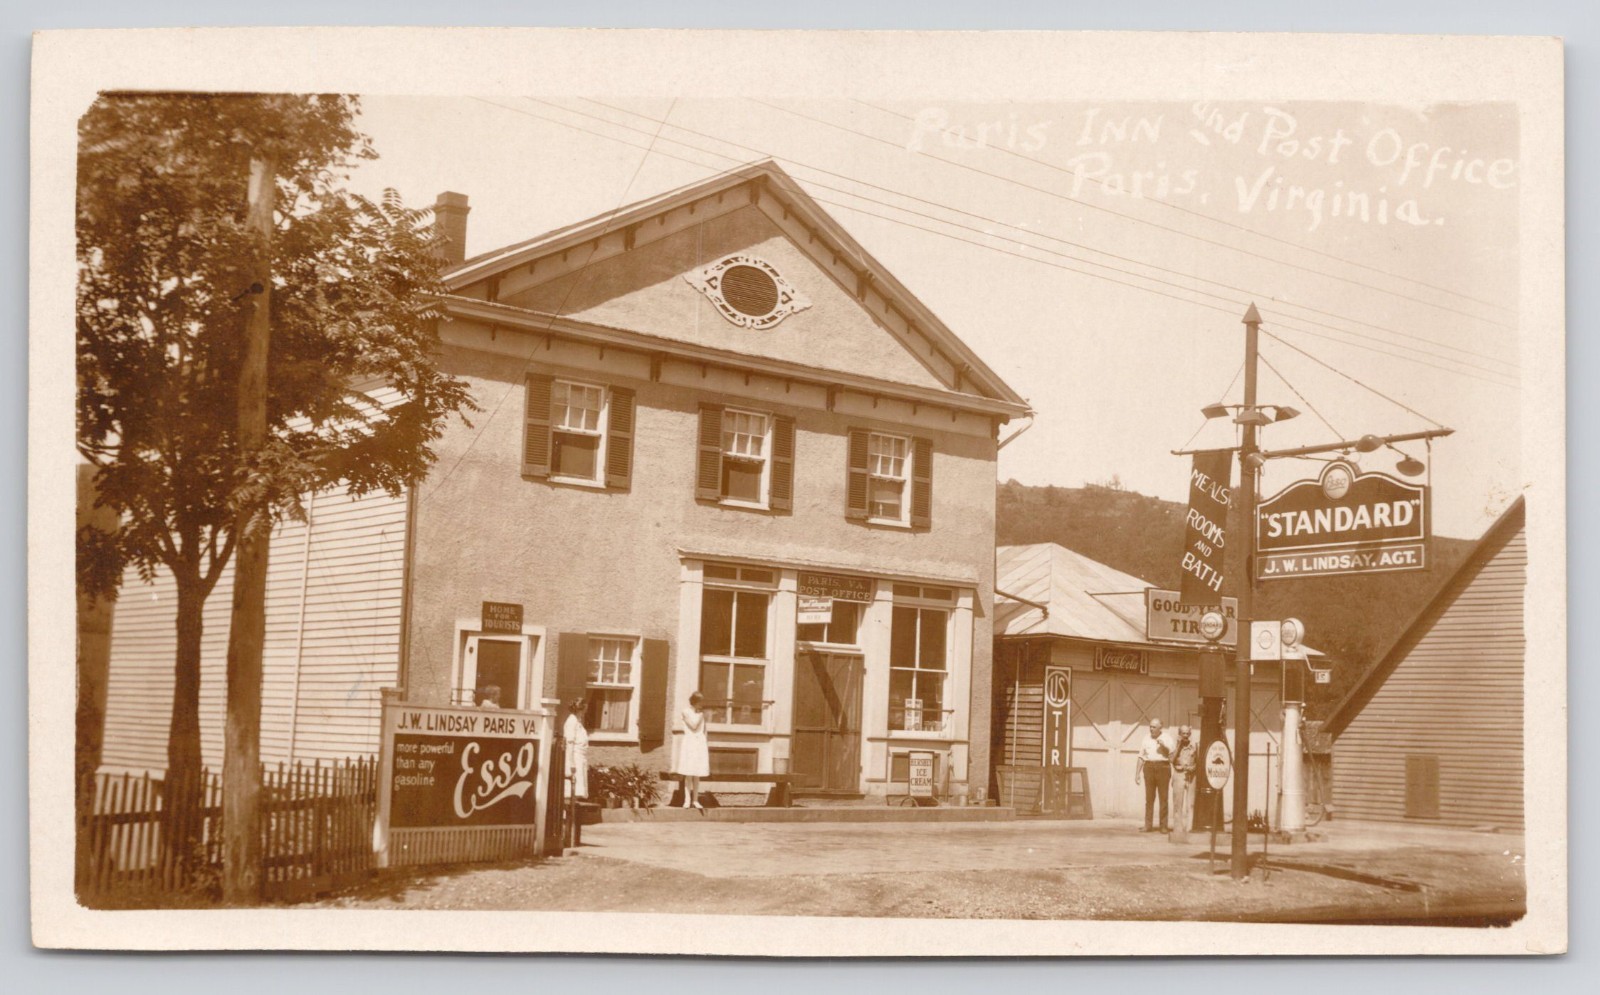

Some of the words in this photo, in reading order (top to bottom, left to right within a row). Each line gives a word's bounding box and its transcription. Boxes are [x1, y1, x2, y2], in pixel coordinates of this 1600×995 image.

[1186, 507, 1225, 549] ROOMS
[1194, 540, 1212, 557] AND
[1379, 550, 1417, 566] AGT.
[1182, 551, 1224, 592] BATH
[799, 585, 828, 597] POST
[832, 589, 871, 601] OFFICE
[484, 619, 520, 631] TOURISTS
[1171, 618, 1200, 635] TIR
[426, 713, 478, 733] LINDSAY
[483, 717, 516, 735] PARIS
[396, 743, 417, 753] more
[420, 741, 455, 755] powerful
[396, 757, 416, 769] than
[418, 760, 436, 773] any
[916, 768, 928, 776] ICE
[394, 773, 435, 791] gasoline
[454, 741, 534, 819] Esso
[911, 777, 932, 786] CREAM
